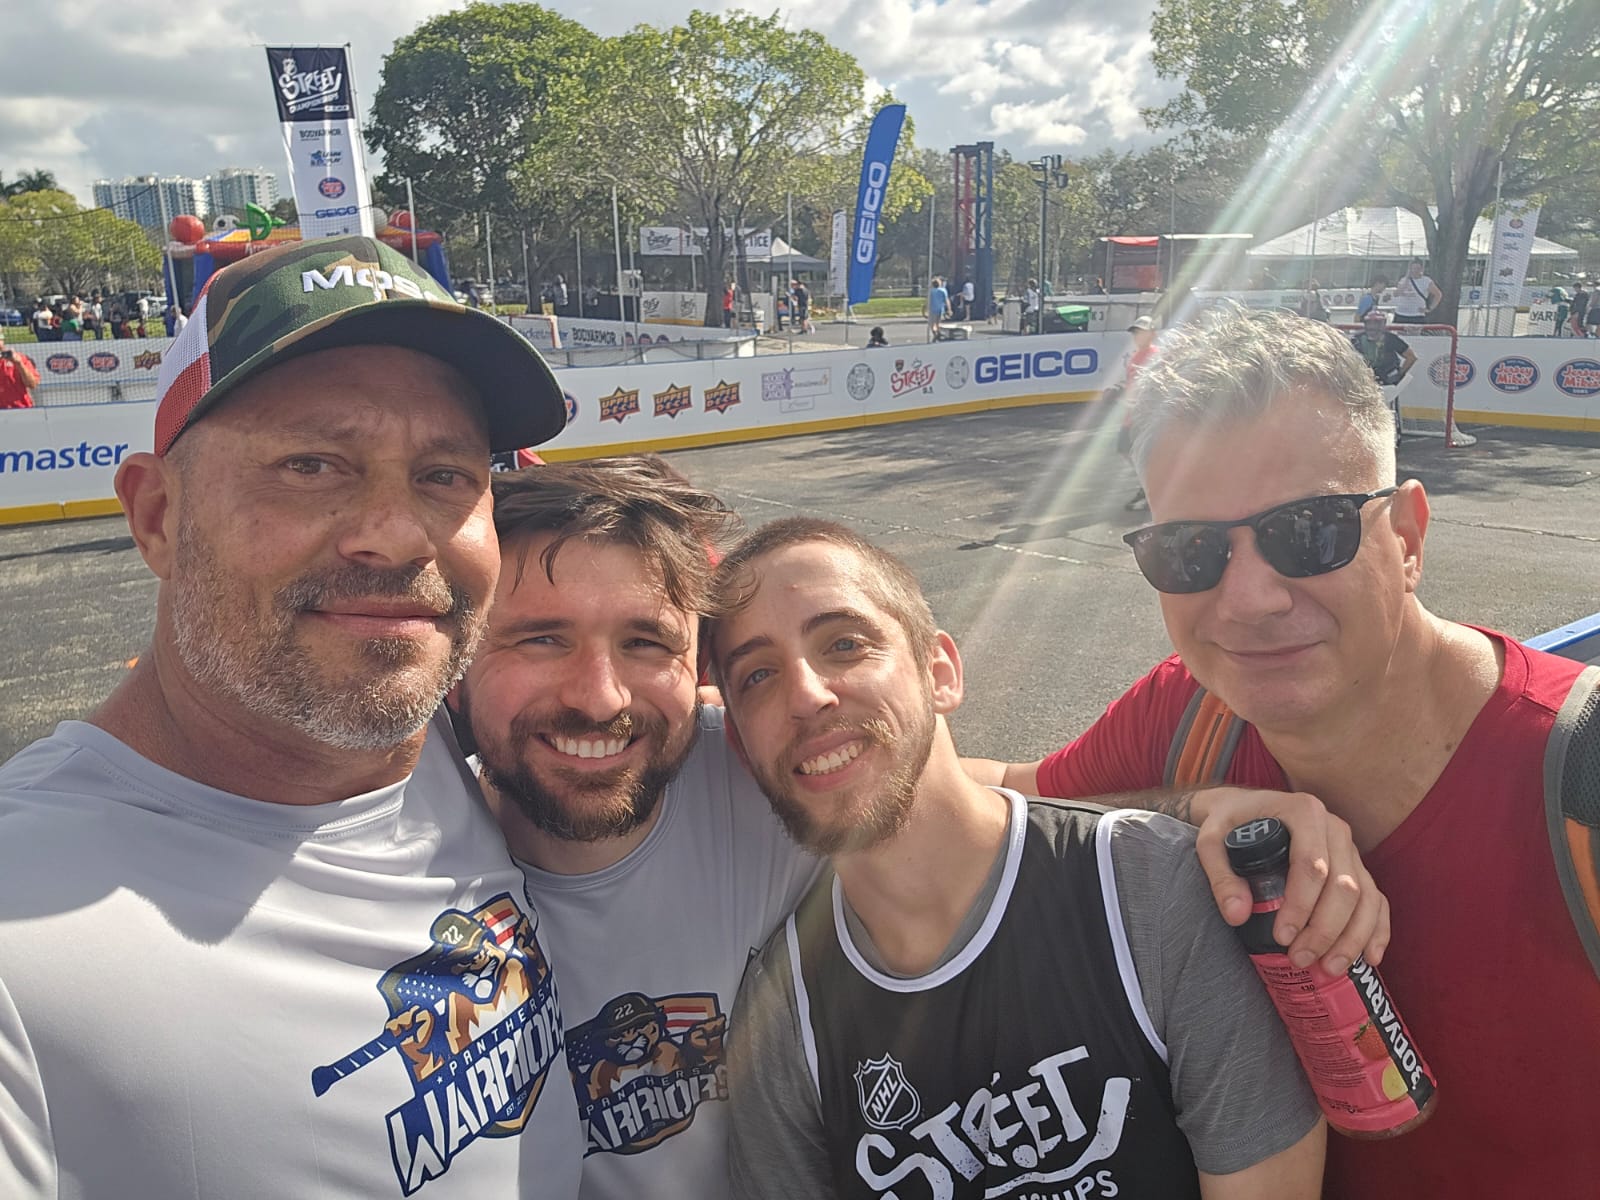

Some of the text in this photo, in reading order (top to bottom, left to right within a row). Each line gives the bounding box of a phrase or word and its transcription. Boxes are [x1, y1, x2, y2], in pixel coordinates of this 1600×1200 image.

[278, 66, 337, 100] STREET
[315, 206, 357, 218] GEICO
[856, 161, 887, 264] GEICO
[890, 363, 933, 393] STREET
[974, 349, 1098, 385] GEICO
[1496, 362, 1533, 377] Jersey
[602, 394, 637, 408] UPPER
[602, 400, 637, 415] DECK
[656, 391, 689, 404] UPPER
[656, 398, 689, 412] DECK
[705, 387, 739, 400] UPPER
[706, 394, 739, 407] DECK
[0, 442, 128, 473] master
[442, 925, 464, 945] 22
[614, 1003, 635, 1021] 22
[1352, 952, 1424, 1090] BODYARMO
[449, 988, 545, 1077] PANTHERS
[586, 1066, 701, 1116] PANTHERS
[869, 1073, 899, 1120] NHL
[588, 1063, 729, 1150] ARRIORS
[855, 1045, 1090, 1200] STREET
